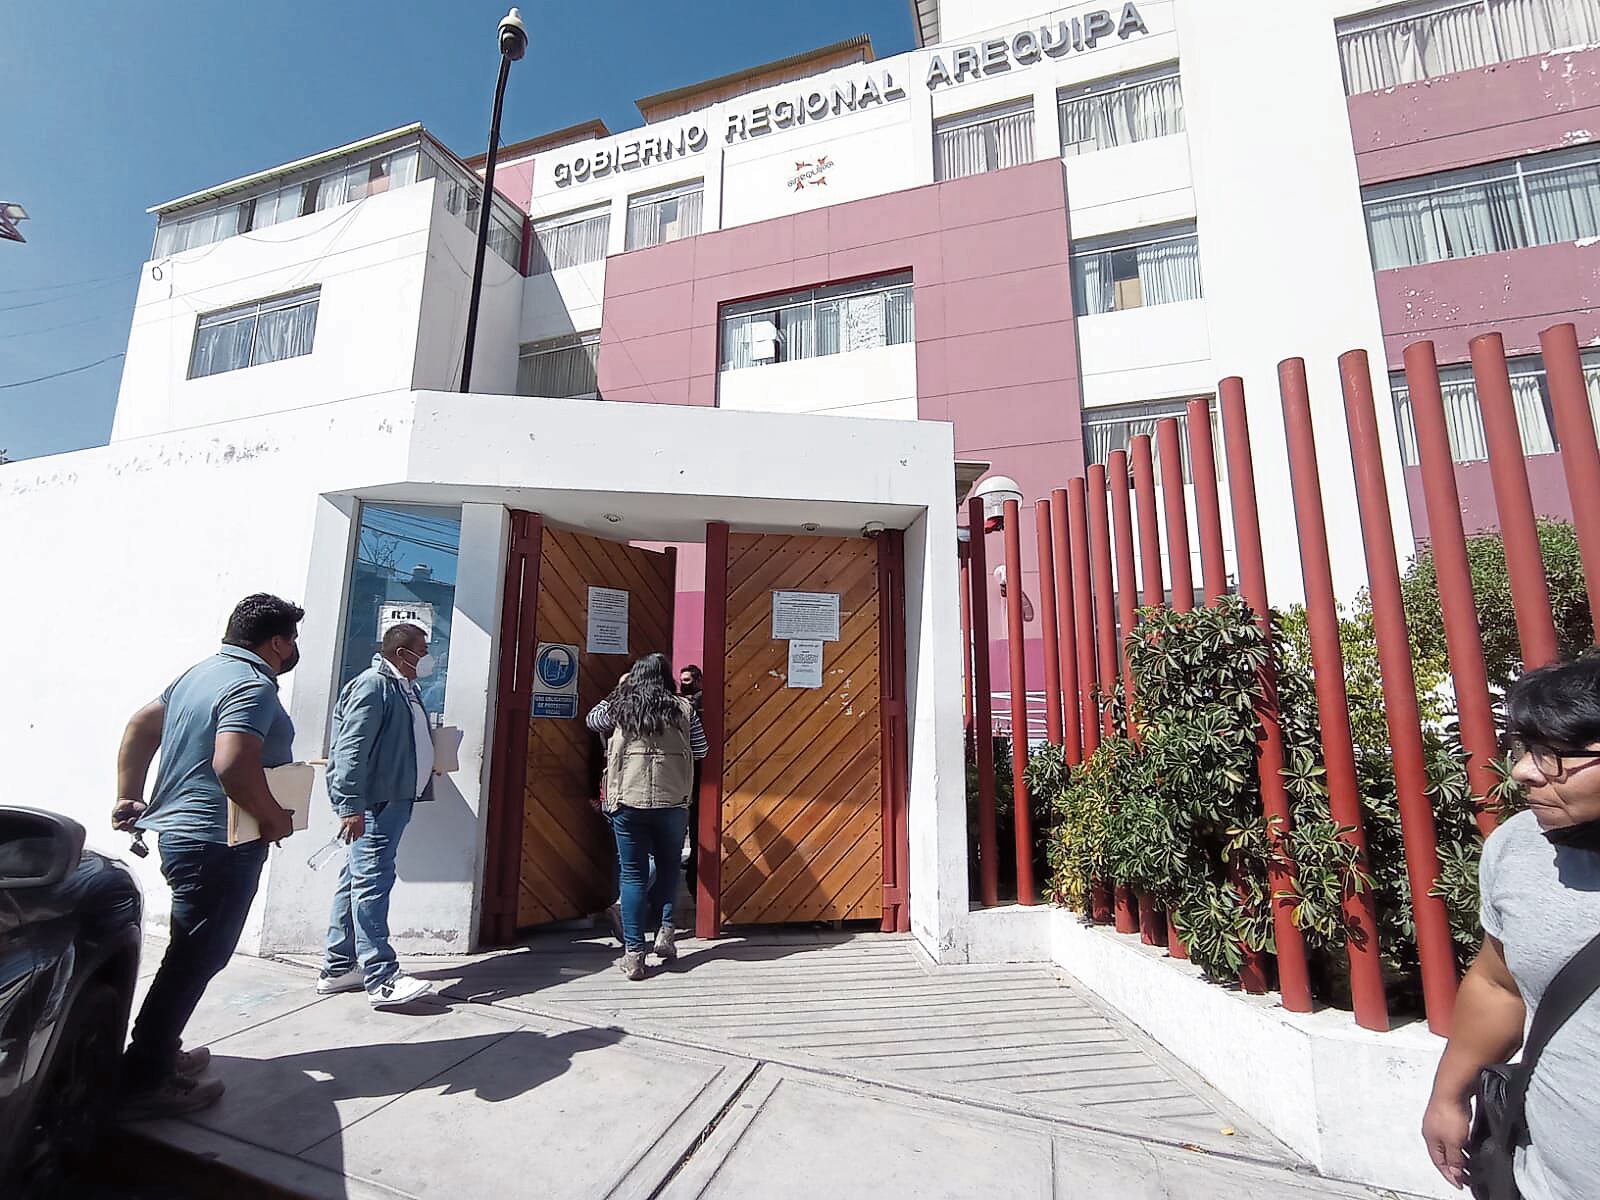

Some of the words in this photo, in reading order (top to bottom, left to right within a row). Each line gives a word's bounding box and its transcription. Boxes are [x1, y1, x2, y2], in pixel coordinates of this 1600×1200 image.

[553, 123, 709, 188] GOBIERNO
[725, 69, 906, 144] REGIONAL
[926, 2, 1149, 90] AREQUIPA
